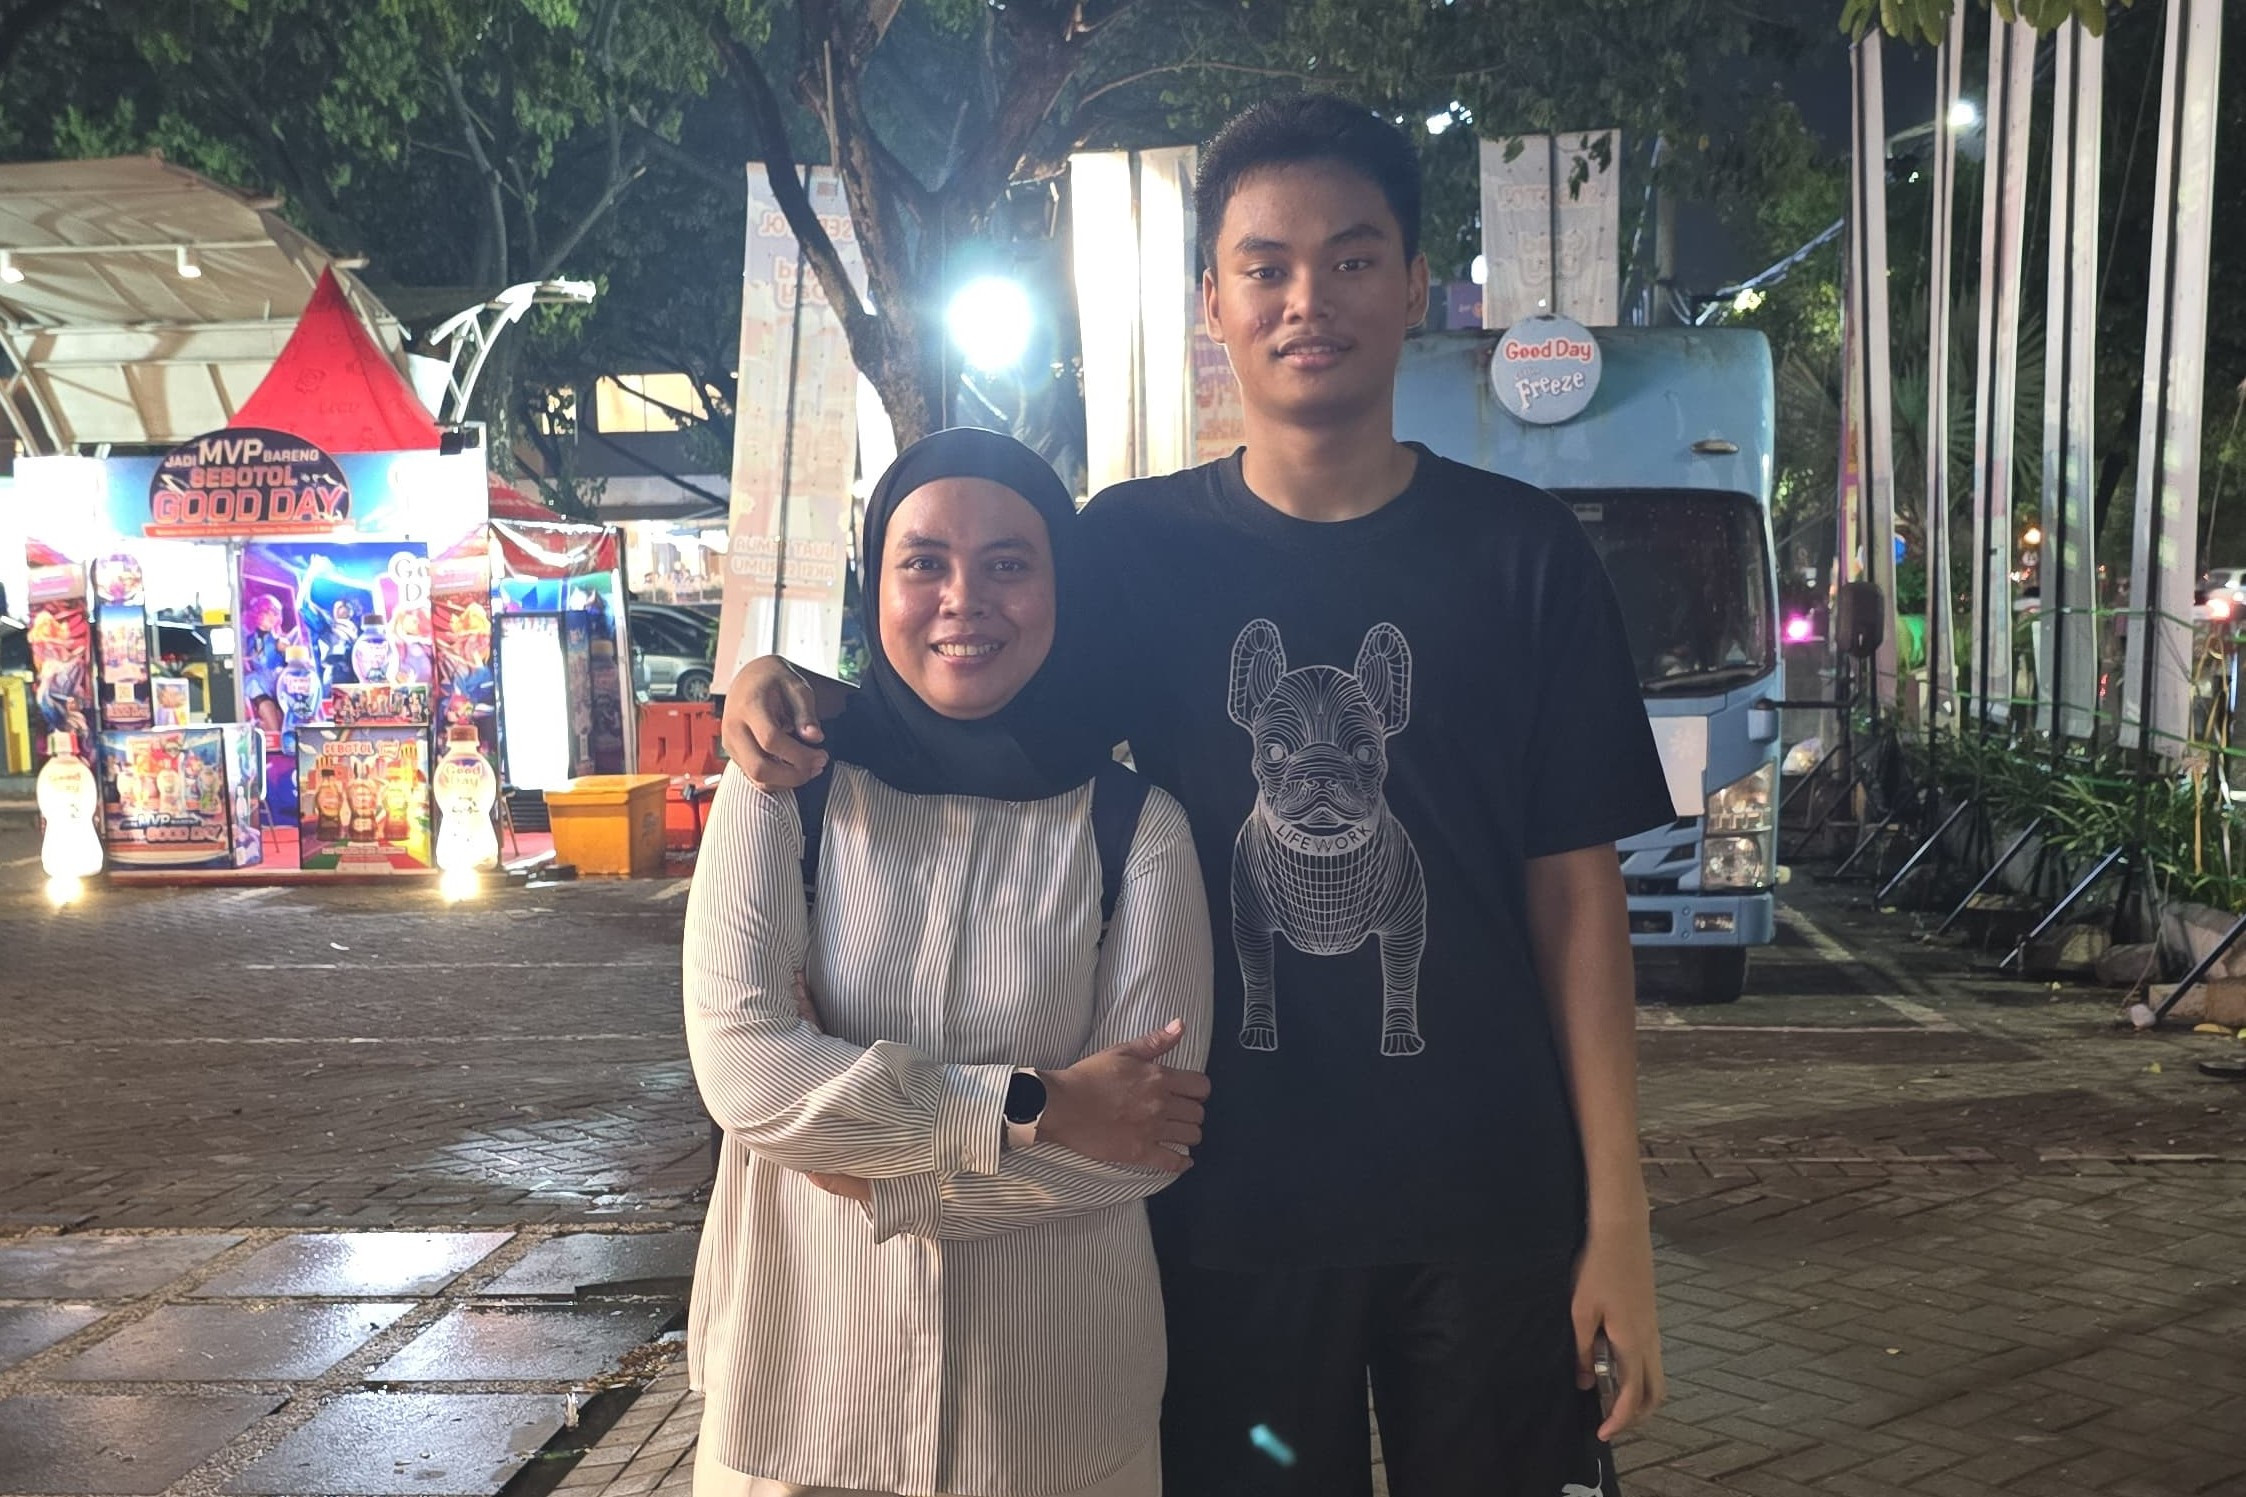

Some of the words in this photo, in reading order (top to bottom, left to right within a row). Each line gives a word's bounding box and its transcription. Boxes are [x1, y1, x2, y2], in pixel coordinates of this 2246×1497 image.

[1505, 339, 1553, 361] Good
[1555, 338, 1593, 363] Day
[1515, 370, 1586, 410] Freeze
[164, 454, 197, 469] JADI
[198, 438, 265, 466] MVP
[188, 464, 299, 489] SEBOTOL
[152, 488, 262, 525] GOOD
[267, 485, 344, 524] DAY
[1275, 823, 1373, 854] LIFEWORK
